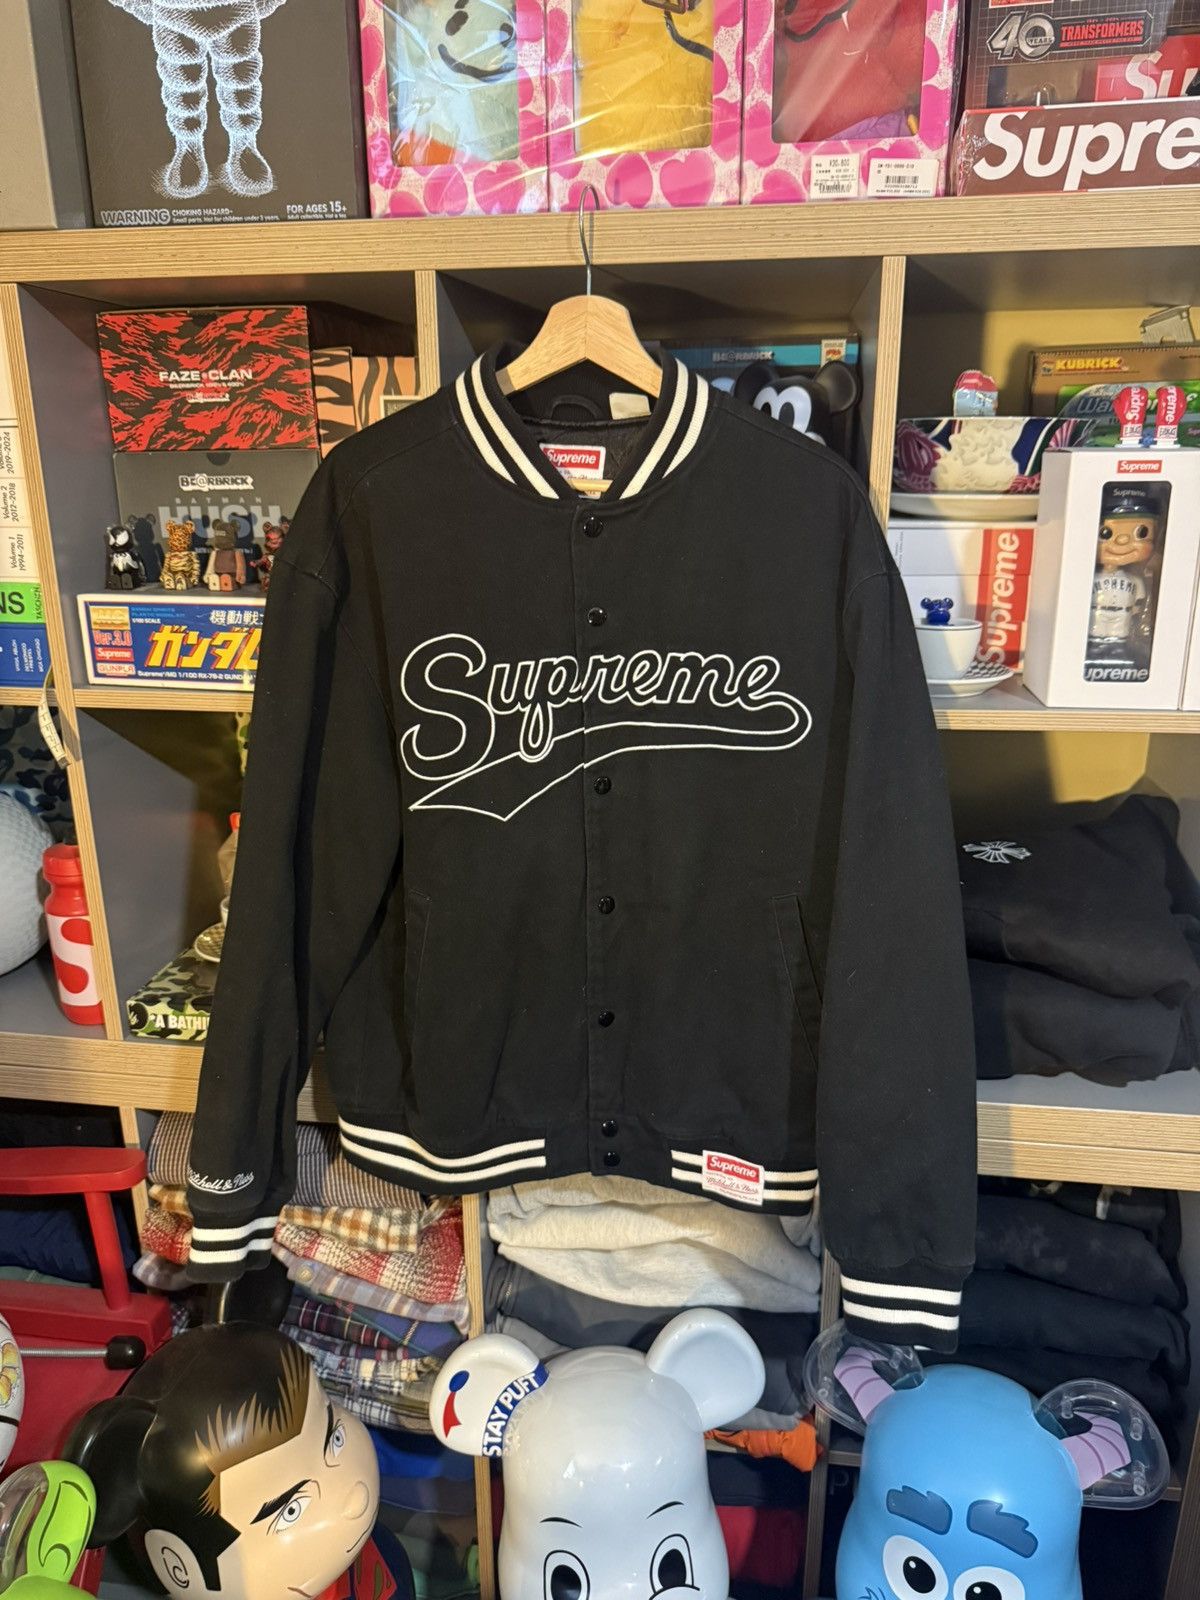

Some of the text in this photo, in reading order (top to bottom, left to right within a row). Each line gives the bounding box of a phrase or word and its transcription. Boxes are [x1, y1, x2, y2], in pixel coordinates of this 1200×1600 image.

[1060, 20, 1144, 41] TRANSFORMERS
[172, 209, 202, 217] CHOKING
[286, 200, 347, 214] FOR AGES 15+
[101, 208, 171, 226] WARNING
[1055, 357, 1121, 371] KUBRICK
[159, 369, 253, 382] FAZE CLAN
[547, 449, 597, 466] Supreme
[1120, 461, 1160, 473] Supreme
[1, 492, 9, 519] Volume
[33, 586, 42, 620] TASCHEN
[976, 532, 1020, 663] Supreme
[98, 648, 131, 659] Supreme
[98, 664, 135, 674] GUNPLA
[224, 673, 253, 681] GUND
[401, 634, 795, 783] Supreme
[168, 1014, 209, 1030] BATHI
[709, 1156, 757, 1178] Supreme
[222, 1179, 233, 1190] &
[482, 1372, 540, 1457] STAY PUFT
